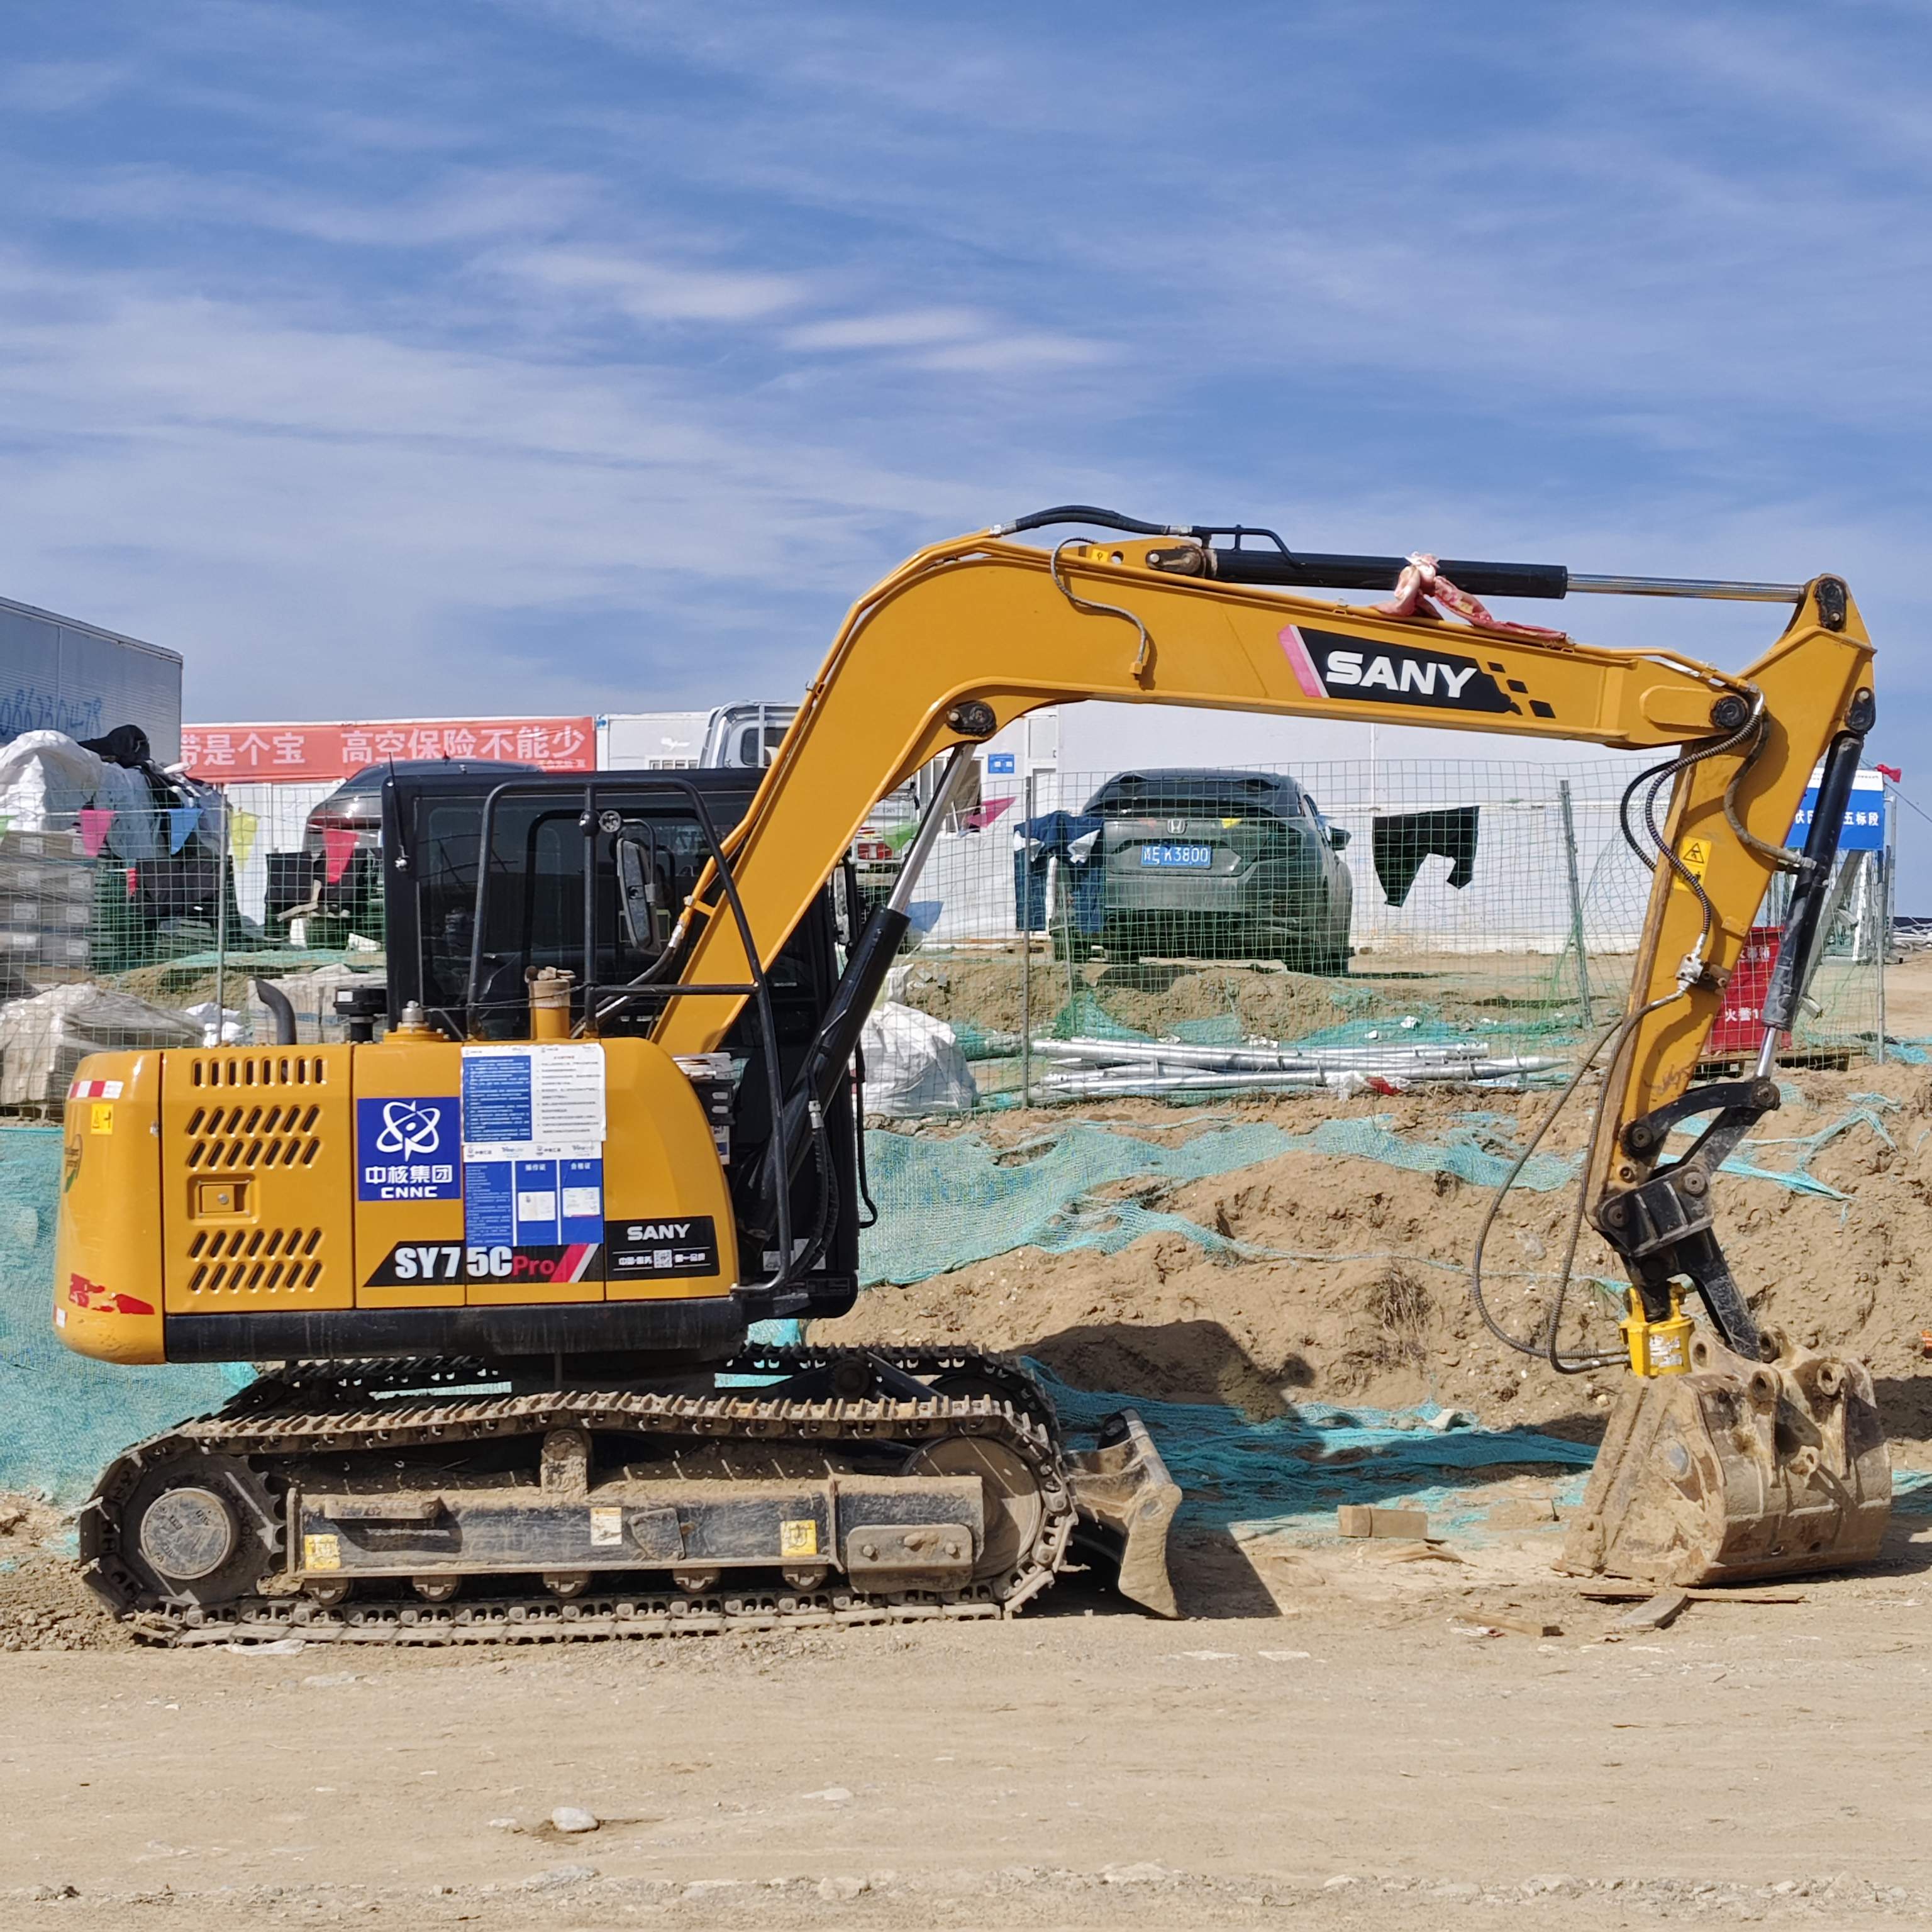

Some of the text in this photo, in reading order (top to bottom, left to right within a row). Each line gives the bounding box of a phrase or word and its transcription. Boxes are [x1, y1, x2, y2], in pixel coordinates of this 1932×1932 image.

[1326, 650, 1477, 698] SANY
[341, 724, 586, 763] 高空保险不能少
[1725, 1008, 1759, 1021] 火警1
[365, 1165, 452, 1184] 中核集团
[381, 1186, 437, 1198] CNNC
[627, 1224, 691, 1241] SANY
